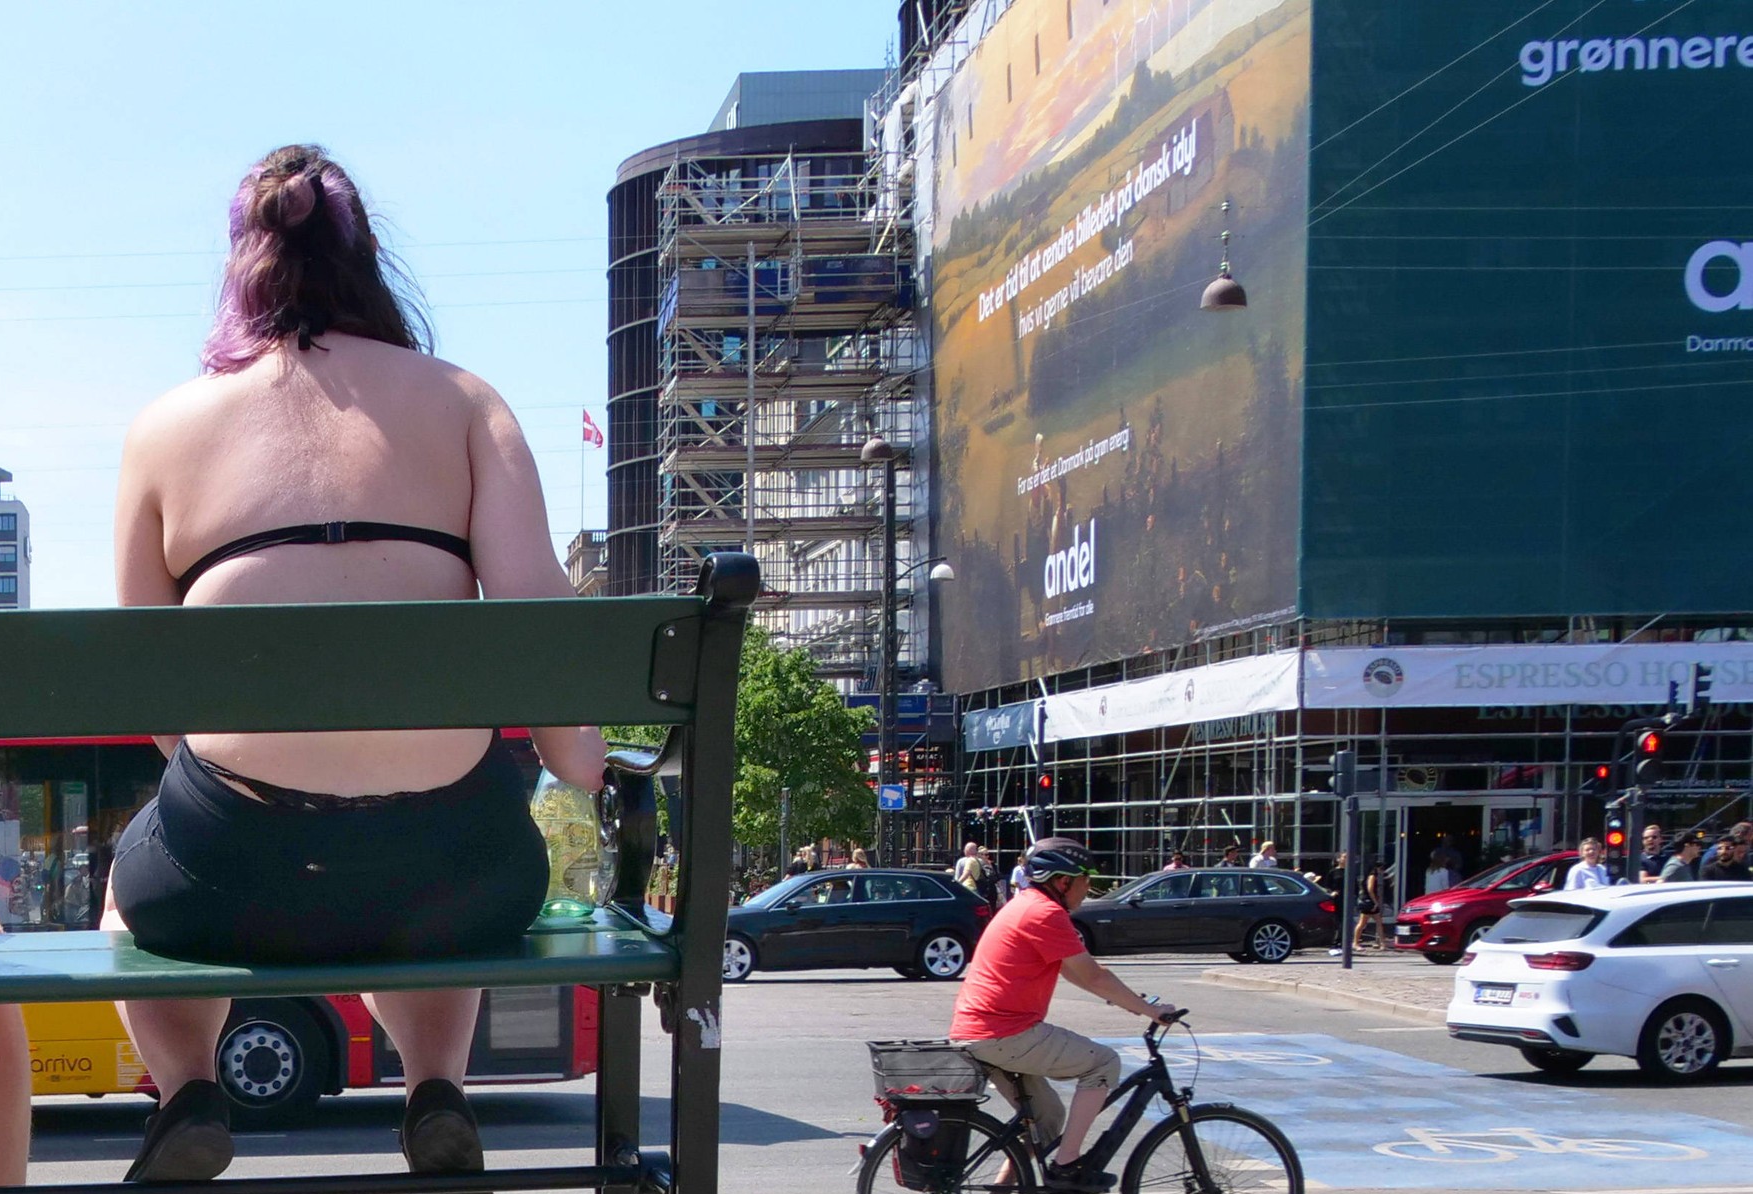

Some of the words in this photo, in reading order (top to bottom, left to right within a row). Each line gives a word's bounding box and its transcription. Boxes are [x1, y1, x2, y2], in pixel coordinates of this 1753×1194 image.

[979, 287, 995, 322] Det
[995, 282, 1006, 310] er
[1006, 263, 1019, 301] tid
[1019, 253, 1030, 291] til
[1030, 249, 1042, 282] at
[1042, 225, 1075, 273] ændre
[1075, 190, 1116, 248] billedet
[1117, 169, 1133, 227] på
[1134, 142, 1171, 203] dansk
[1172, 118, 1197, 176] idyl
[1018, 305, 1035, 339] hvis
[1035, 297, 1044, 327] vi
[1044, 286, 1069, 330] gerne
[1069, 268, 1080, 303] vil
[1080, 254, 1114, 295] bevare
[1114, 237, 1134, 272] den
[1044, 517, 1095, 599] andel
[1454, 661, 1629, 690] ESPRESSO
[30, 1054, 92, 1073] arriva
